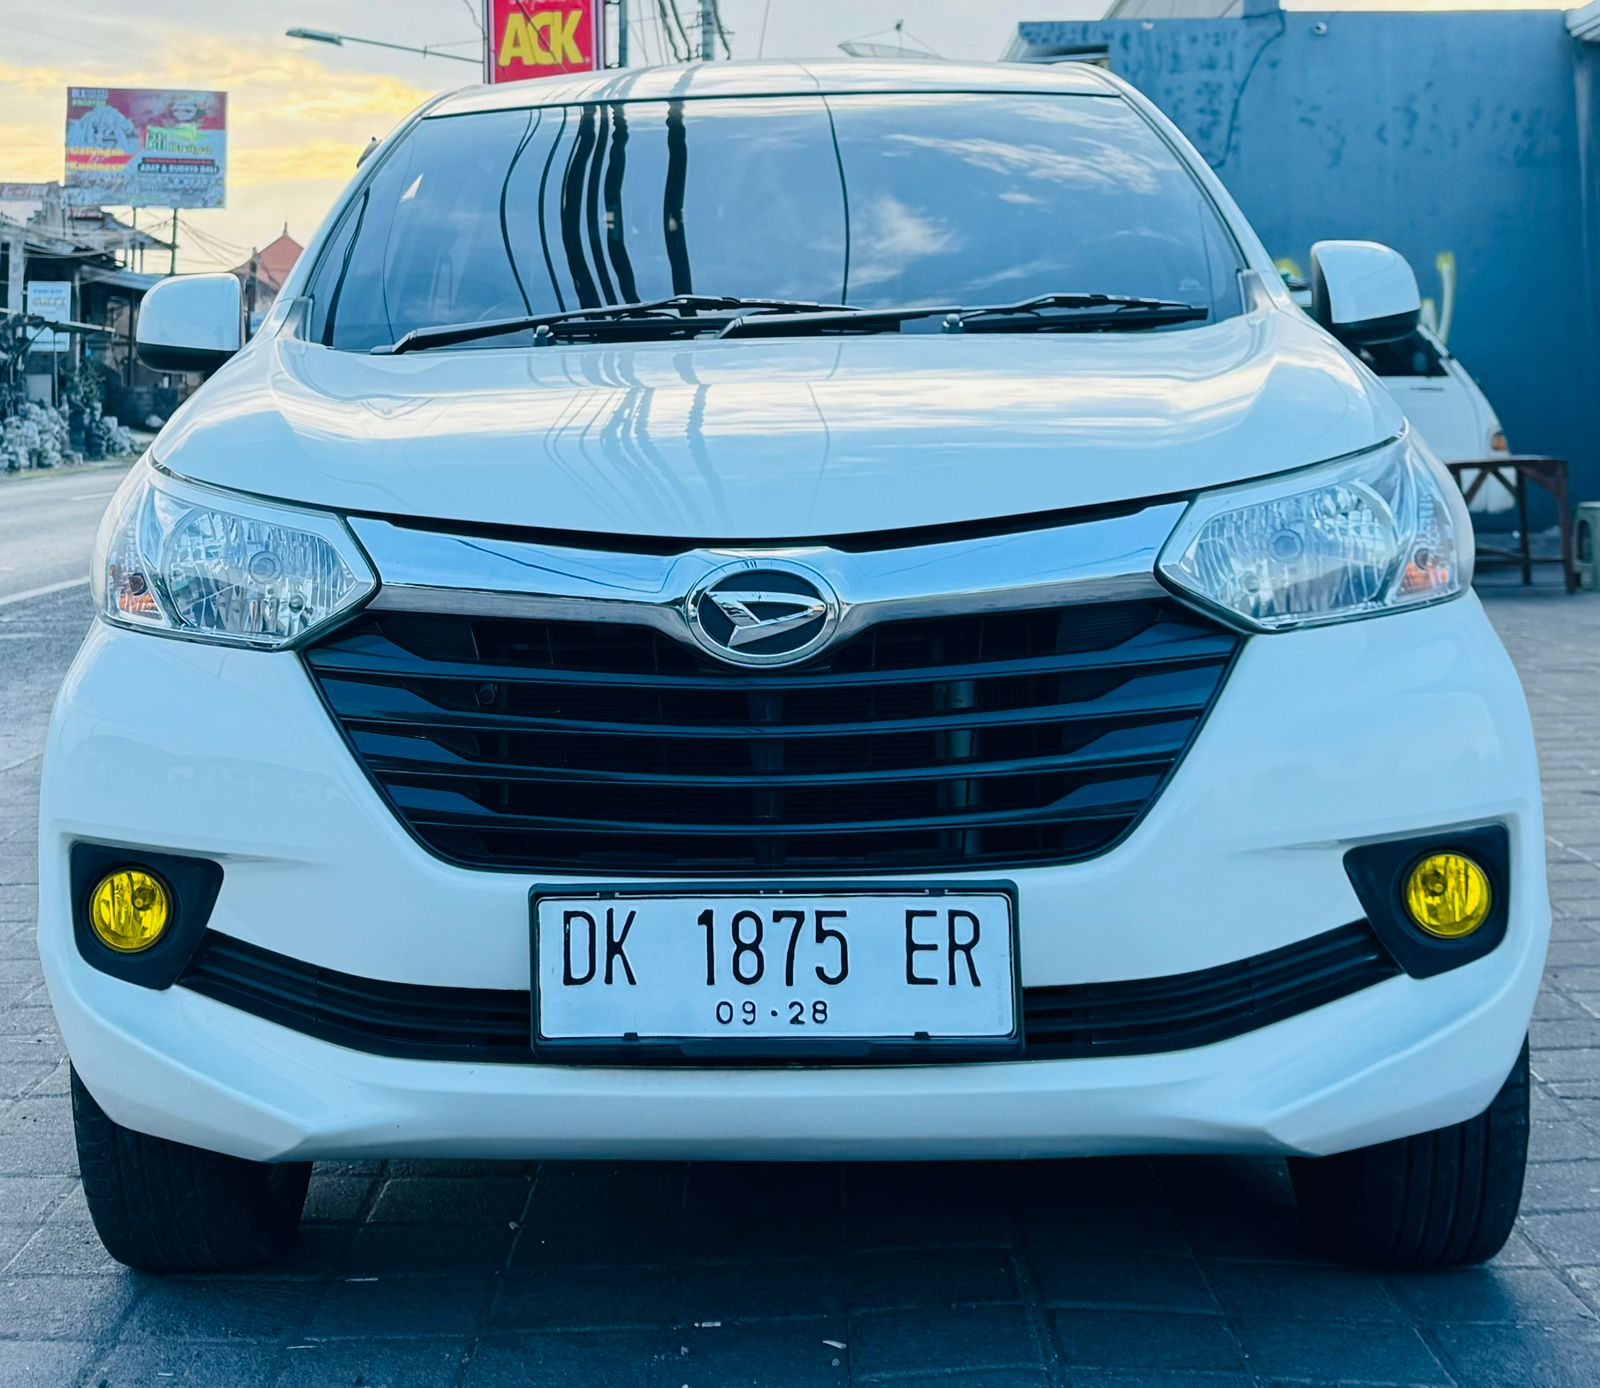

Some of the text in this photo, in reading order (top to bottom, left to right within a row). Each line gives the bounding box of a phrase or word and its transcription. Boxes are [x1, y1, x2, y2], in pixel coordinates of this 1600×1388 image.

[498, 10, 584, 67] ACK
[562, 908, 982, 987] DK 1875 ER
